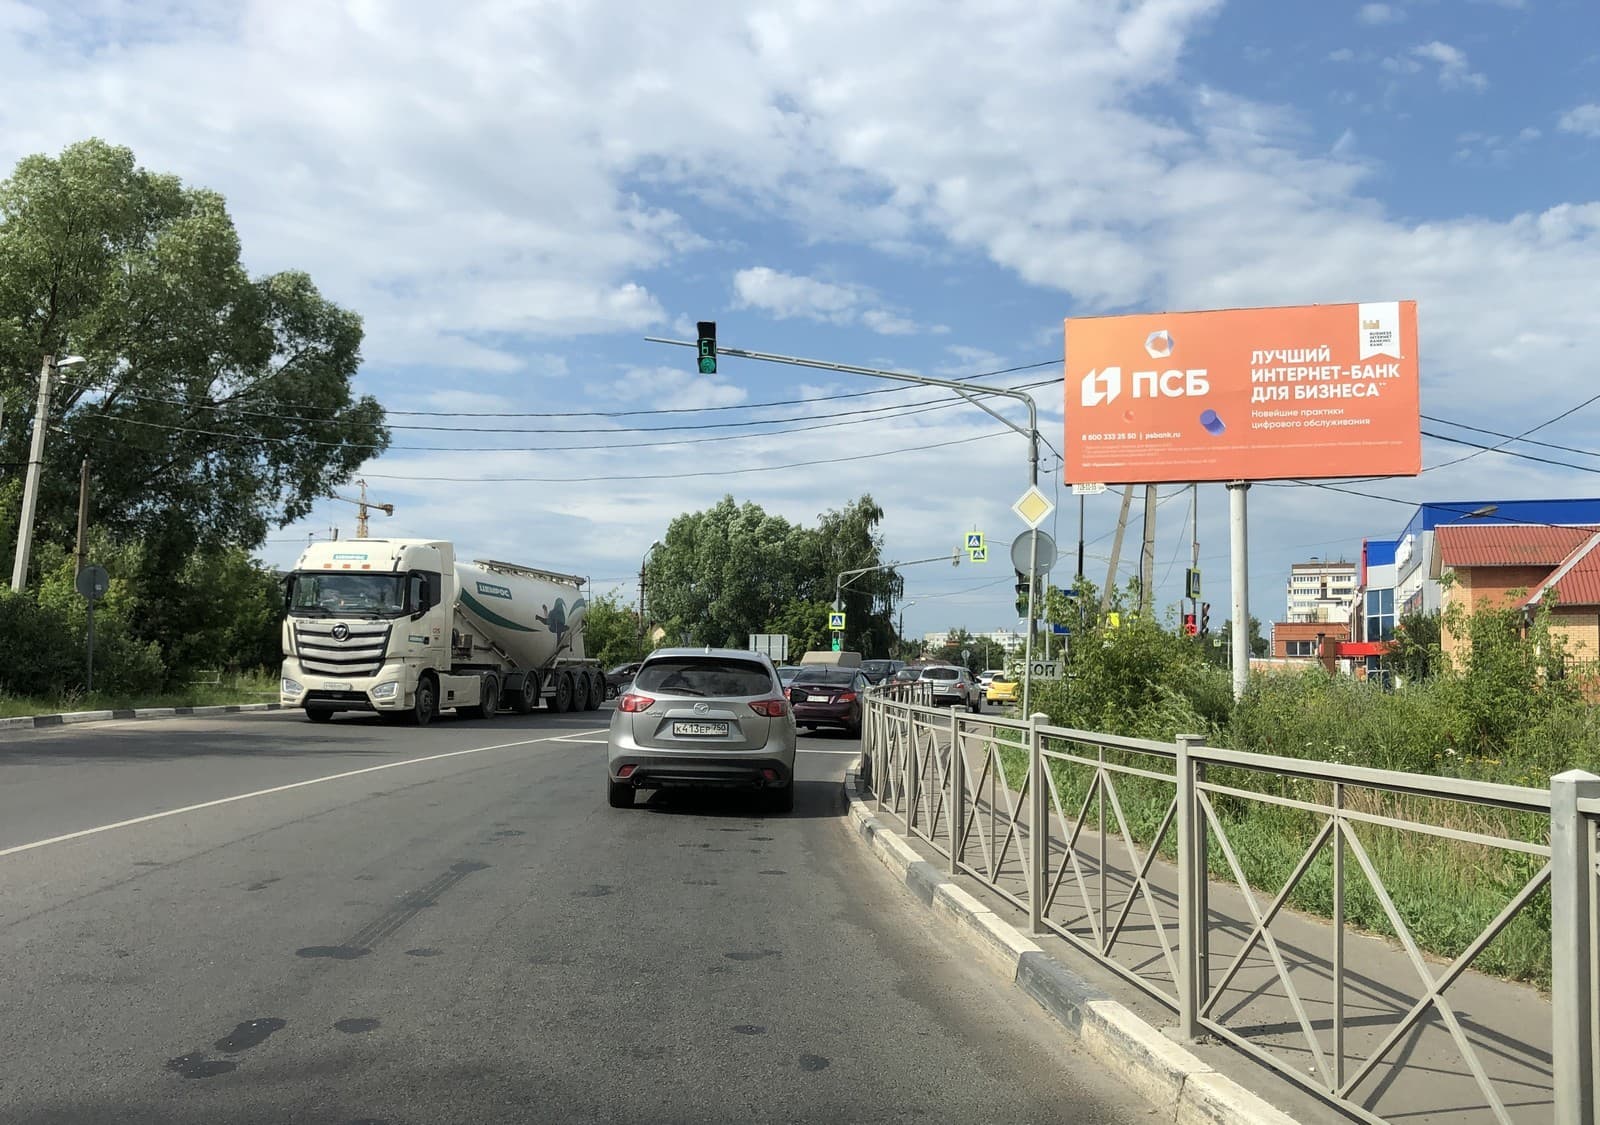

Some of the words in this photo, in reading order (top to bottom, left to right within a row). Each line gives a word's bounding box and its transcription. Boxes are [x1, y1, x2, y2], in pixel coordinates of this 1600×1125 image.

[1251, 345, 1330, 365] ЛУЧШИЙ
[1251, 363, 1401, 383] ИНТЕРНЕТ-БАНК
[1132, 369, 1210, 398] ПСБ
[1251, 386, 1289, 403] ДЛЯ
[1251, 409, 1299, 418] Новейшие
[1300, 408, 1344, 419] практики
[1251, 419, 1301, 431] цифрового
[1303, 418, 1370, 429] обслуживания
